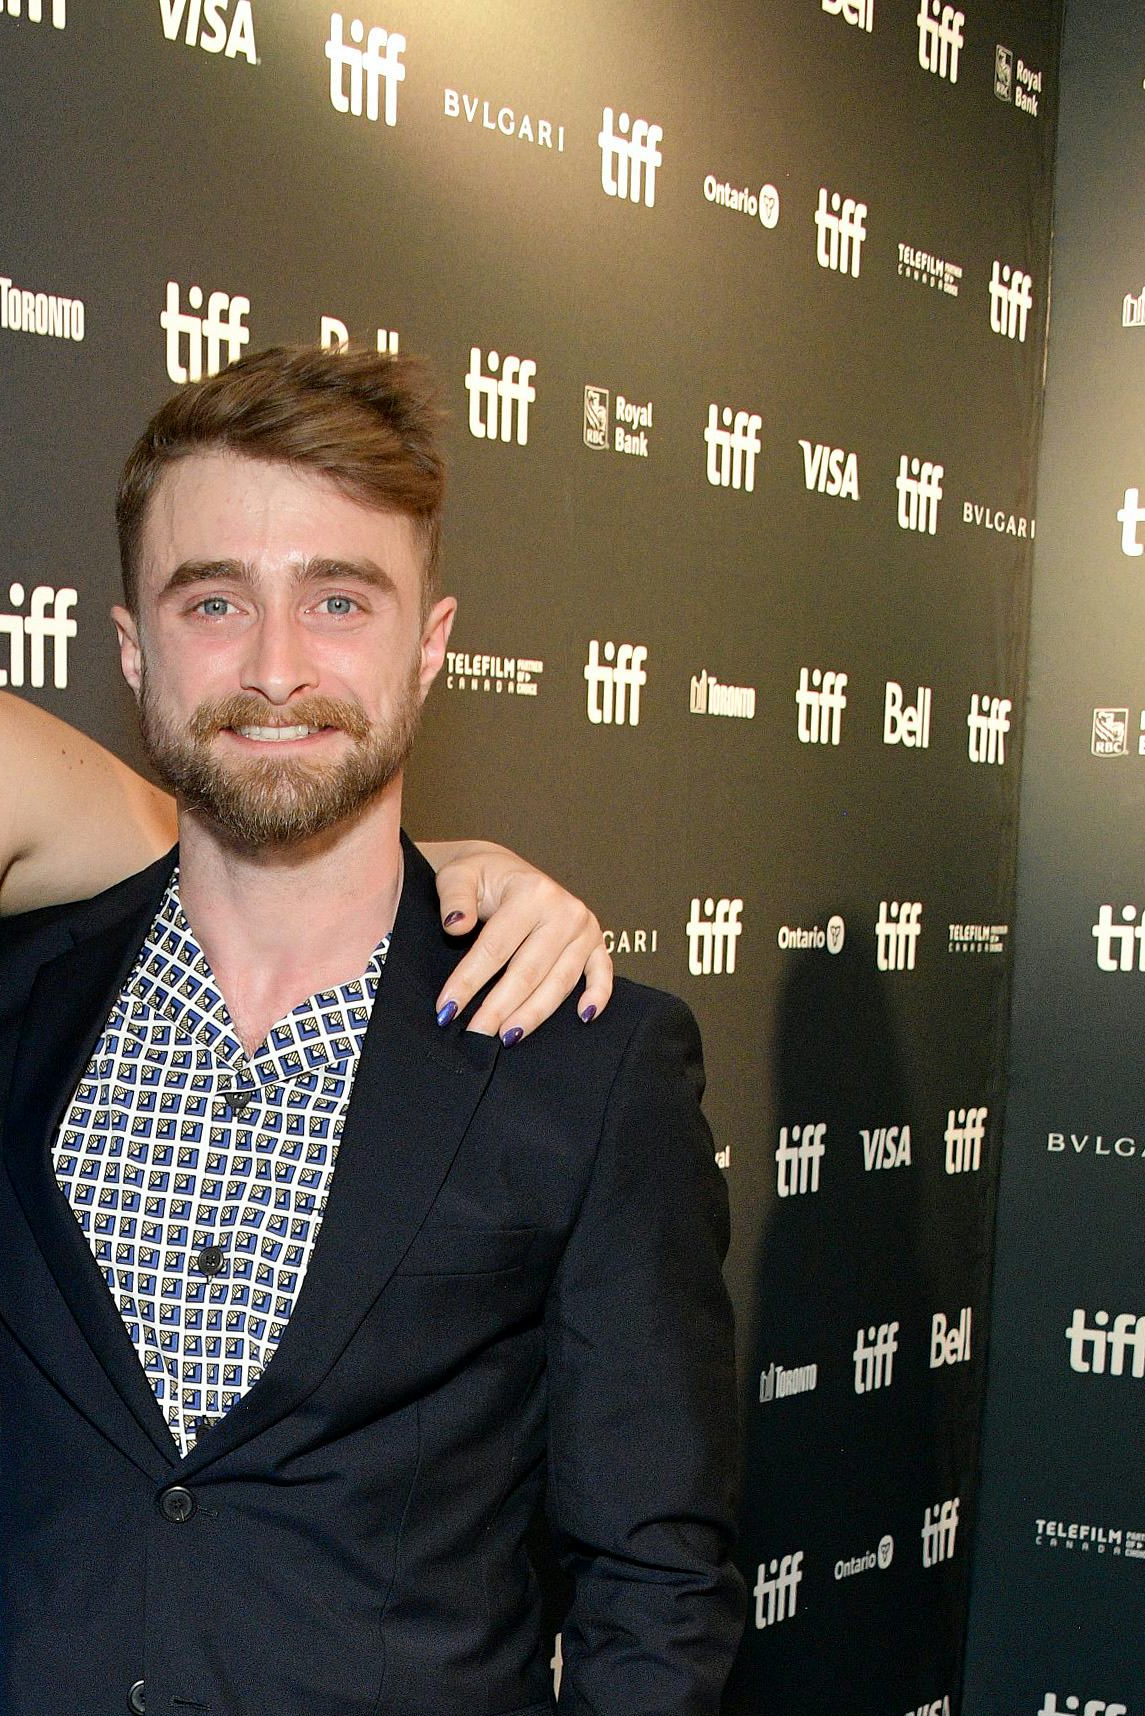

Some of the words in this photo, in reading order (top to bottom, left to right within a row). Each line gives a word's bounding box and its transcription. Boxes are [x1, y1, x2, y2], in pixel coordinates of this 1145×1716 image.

[159, 0, 256, 65] VISA
[917, 0, 964, 83] tiff
[325, 12, 406, 126] tiff
[1015, 86, 1038, 117] Bank
[1016, 60, 1042, 93] Royal
[445, 89, 564, 151] BVLGARI
[598, 107, 662, 207] tiff
[704, 175, 757, 215] Ontario
[815, 188, 867, 277] tiff
[898, 243, 944, 278] TELEFILM
[160, 281, 251, 385] tiff
[989, 261, 1032, 342] tiff
[465, 348, 536, 445] tiff
[616, 396, 653, 429] Royal
[615, 427, 648, 457] Bank
[705, 404, 761, 491] tiff
[799, 440, 858, 500] VISA
[896, 455, 943, 535] tiff
[964, 502, 1035, 538] BVLGARI
[446, 652, 515, 678] TELEFILM
[584, 640, 647, 725] tiff
[708, 677, 755, 718] TORONTO
[796, 668, 847, 745] tiff
[884, 682, 931, 748] Bell
[968, 694, 1011, 764] tiff
[602, 929, 658, 954] GARI
[686, 898, 743, 975] tiff
[778, 926, 824, 950] Ontario
[876, 902, 922, 970] tiff
[1092, 905, 1145, 971] ti
[776, 1123, 826, 1197] tiff
[860, 1126, 911, 1171] VISA
[944, 1107, 987, 1174] tiff
[1048, 1133, 1145, 1157] BVLG
[853, 1322, 899, 1394] tiff
[930, 1308, 971, 1368] Bell
[775, 1364, 816, 1398] TORONTO
[835, 1551, 876, 1579] Ontario
[922, 1498, 959, 1567] tiff
[1036, 1519, 1122, 1545] TELEFILM
[754, 1551, 803, 1629] tiff
